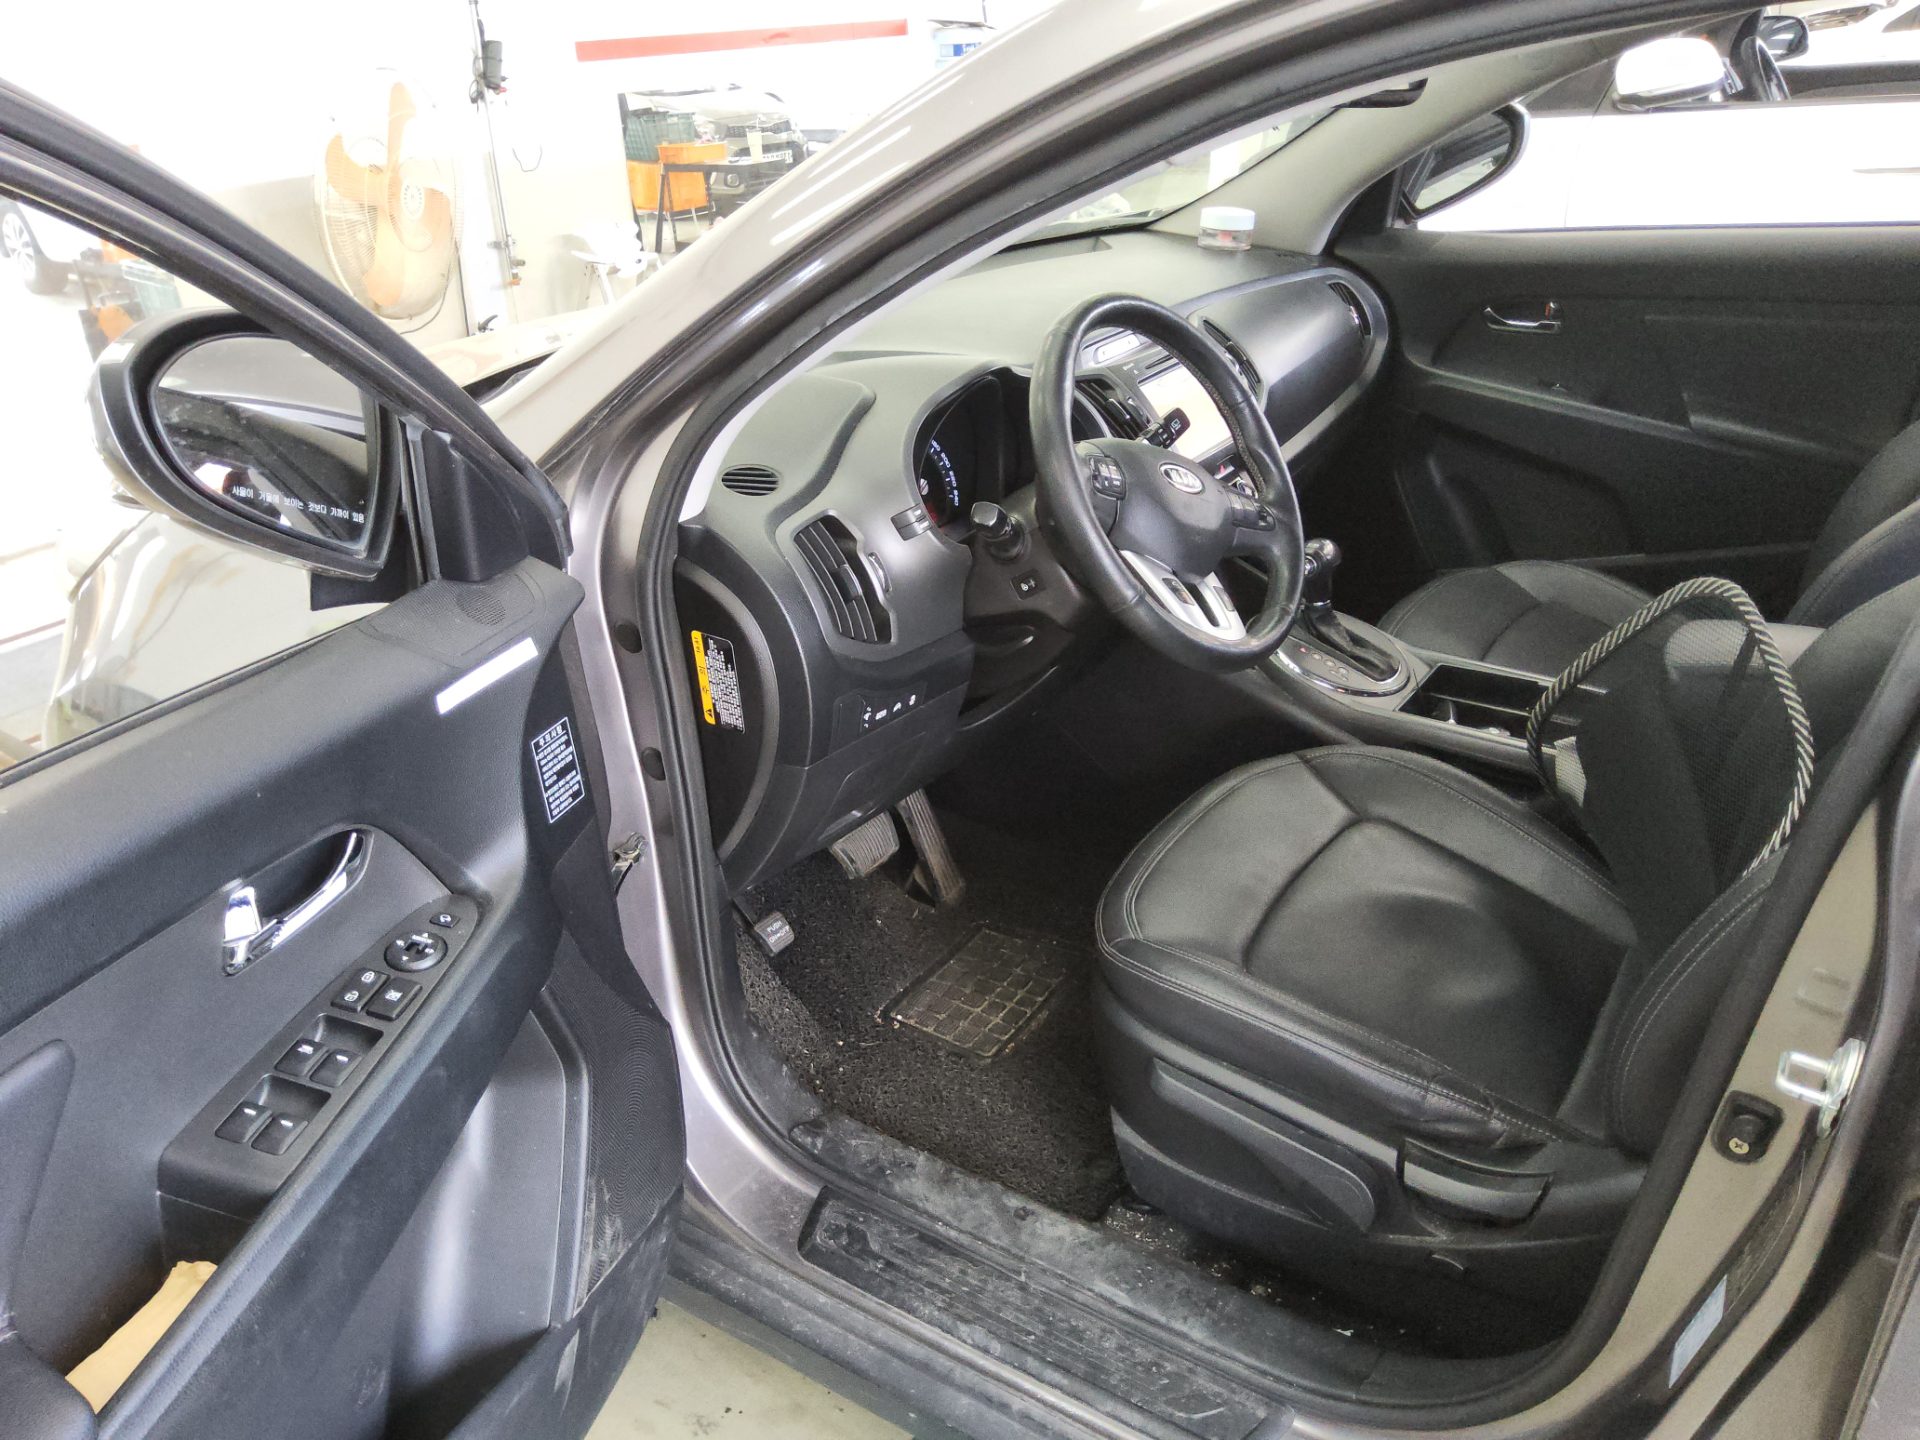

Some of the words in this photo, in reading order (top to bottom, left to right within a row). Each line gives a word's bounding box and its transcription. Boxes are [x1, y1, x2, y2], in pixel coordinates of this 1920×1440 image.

[941, 452, 951, 468] 200
[232, 484, 254, 499] 사물이
[308, 501, 327, 514] 것보다
[330, 507, 350, 520] 가까이
[767, 920, 782, 932] PUSH
